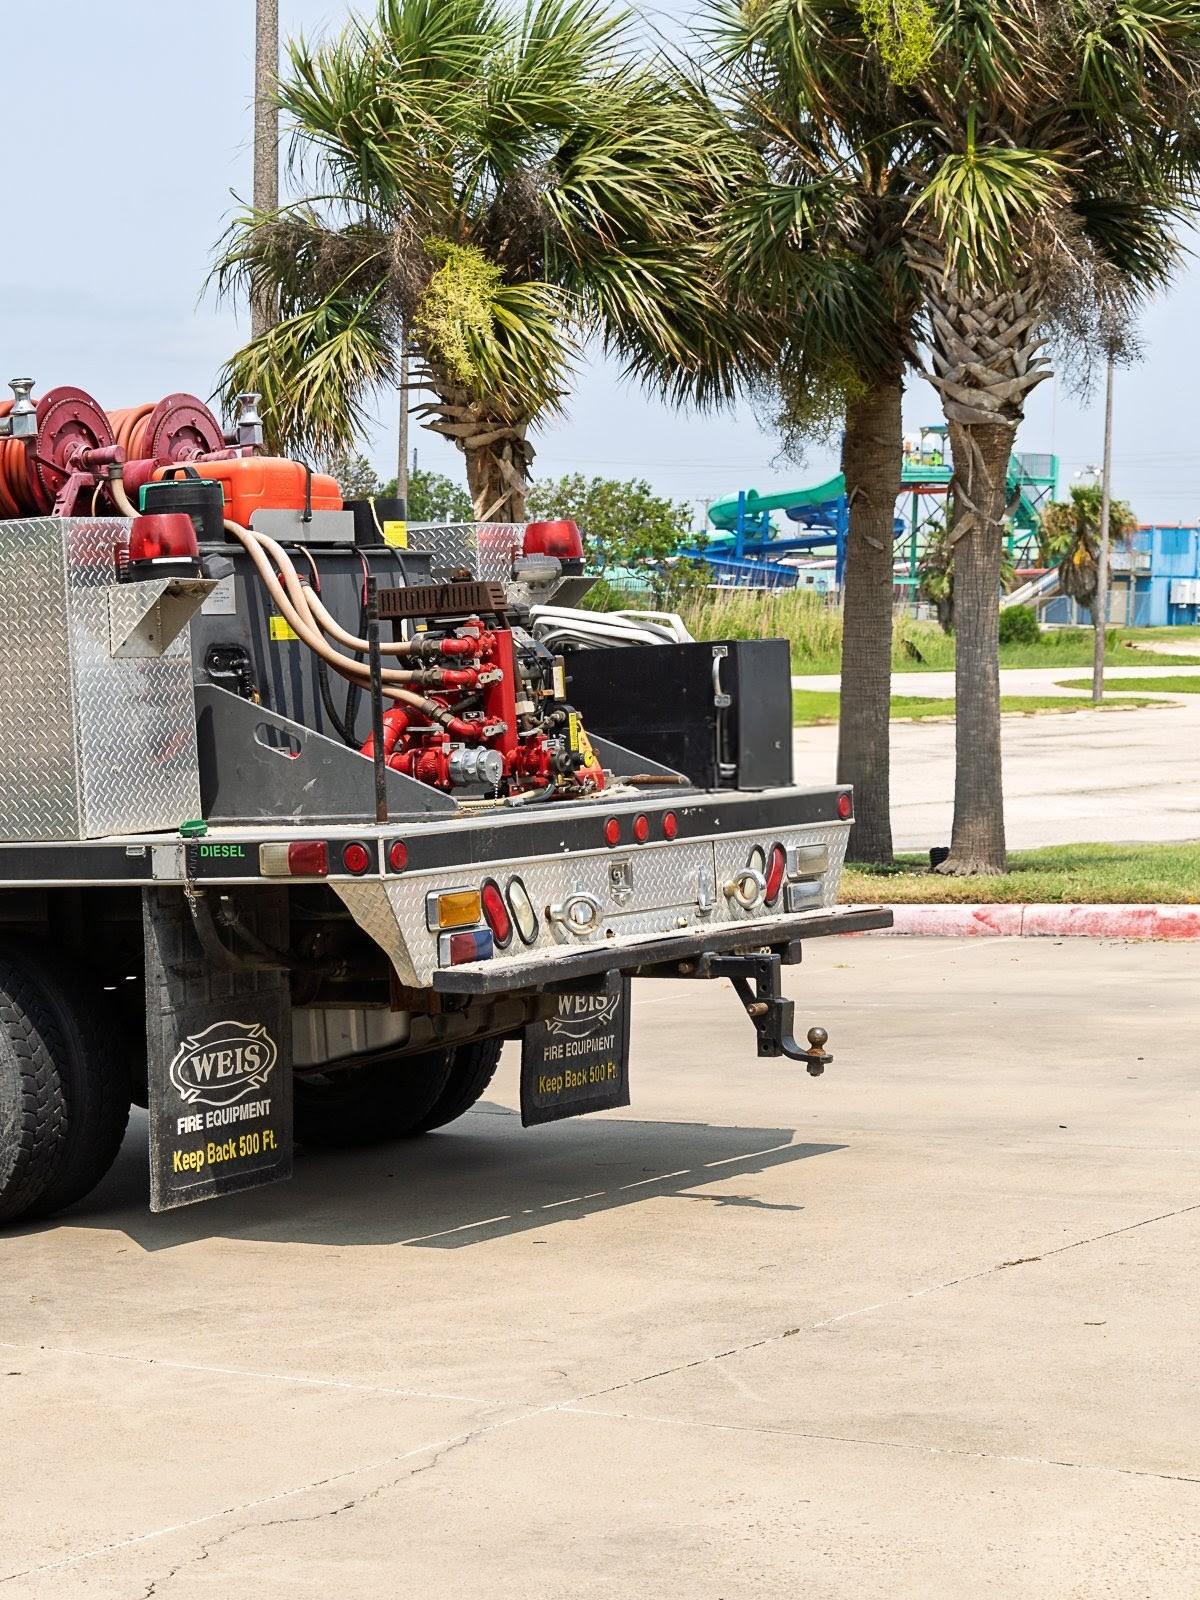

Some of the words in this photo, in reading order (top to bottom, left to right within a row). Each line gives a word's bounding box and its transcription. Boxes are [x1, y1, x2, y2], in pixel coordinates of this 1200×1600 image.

[200, 845, 246, 857] DIESEL
[190, 1044, 261, 1083] WEIS
[543, 1044, 564, 1061] FIRE
[566, 1034, 615, 1057] EQUIPMENT
[538, 1075, 563, 1094] Keep
[565, 1069, 588, 1089] Back
[589, 1064, 605, 1083] 500
[607, 1062, 618, 1080] Ft.
[177, 1113, 204, 1136] FIRE
[206, 1099, 272, 1129] EQUIPMENT
[173, 1149, 205, 1173] Keep
[207, 1138, 237, 1164] Back
[239, 1132, 260, 1157] 500
[263, 1129, 278, 1151] Ft.
